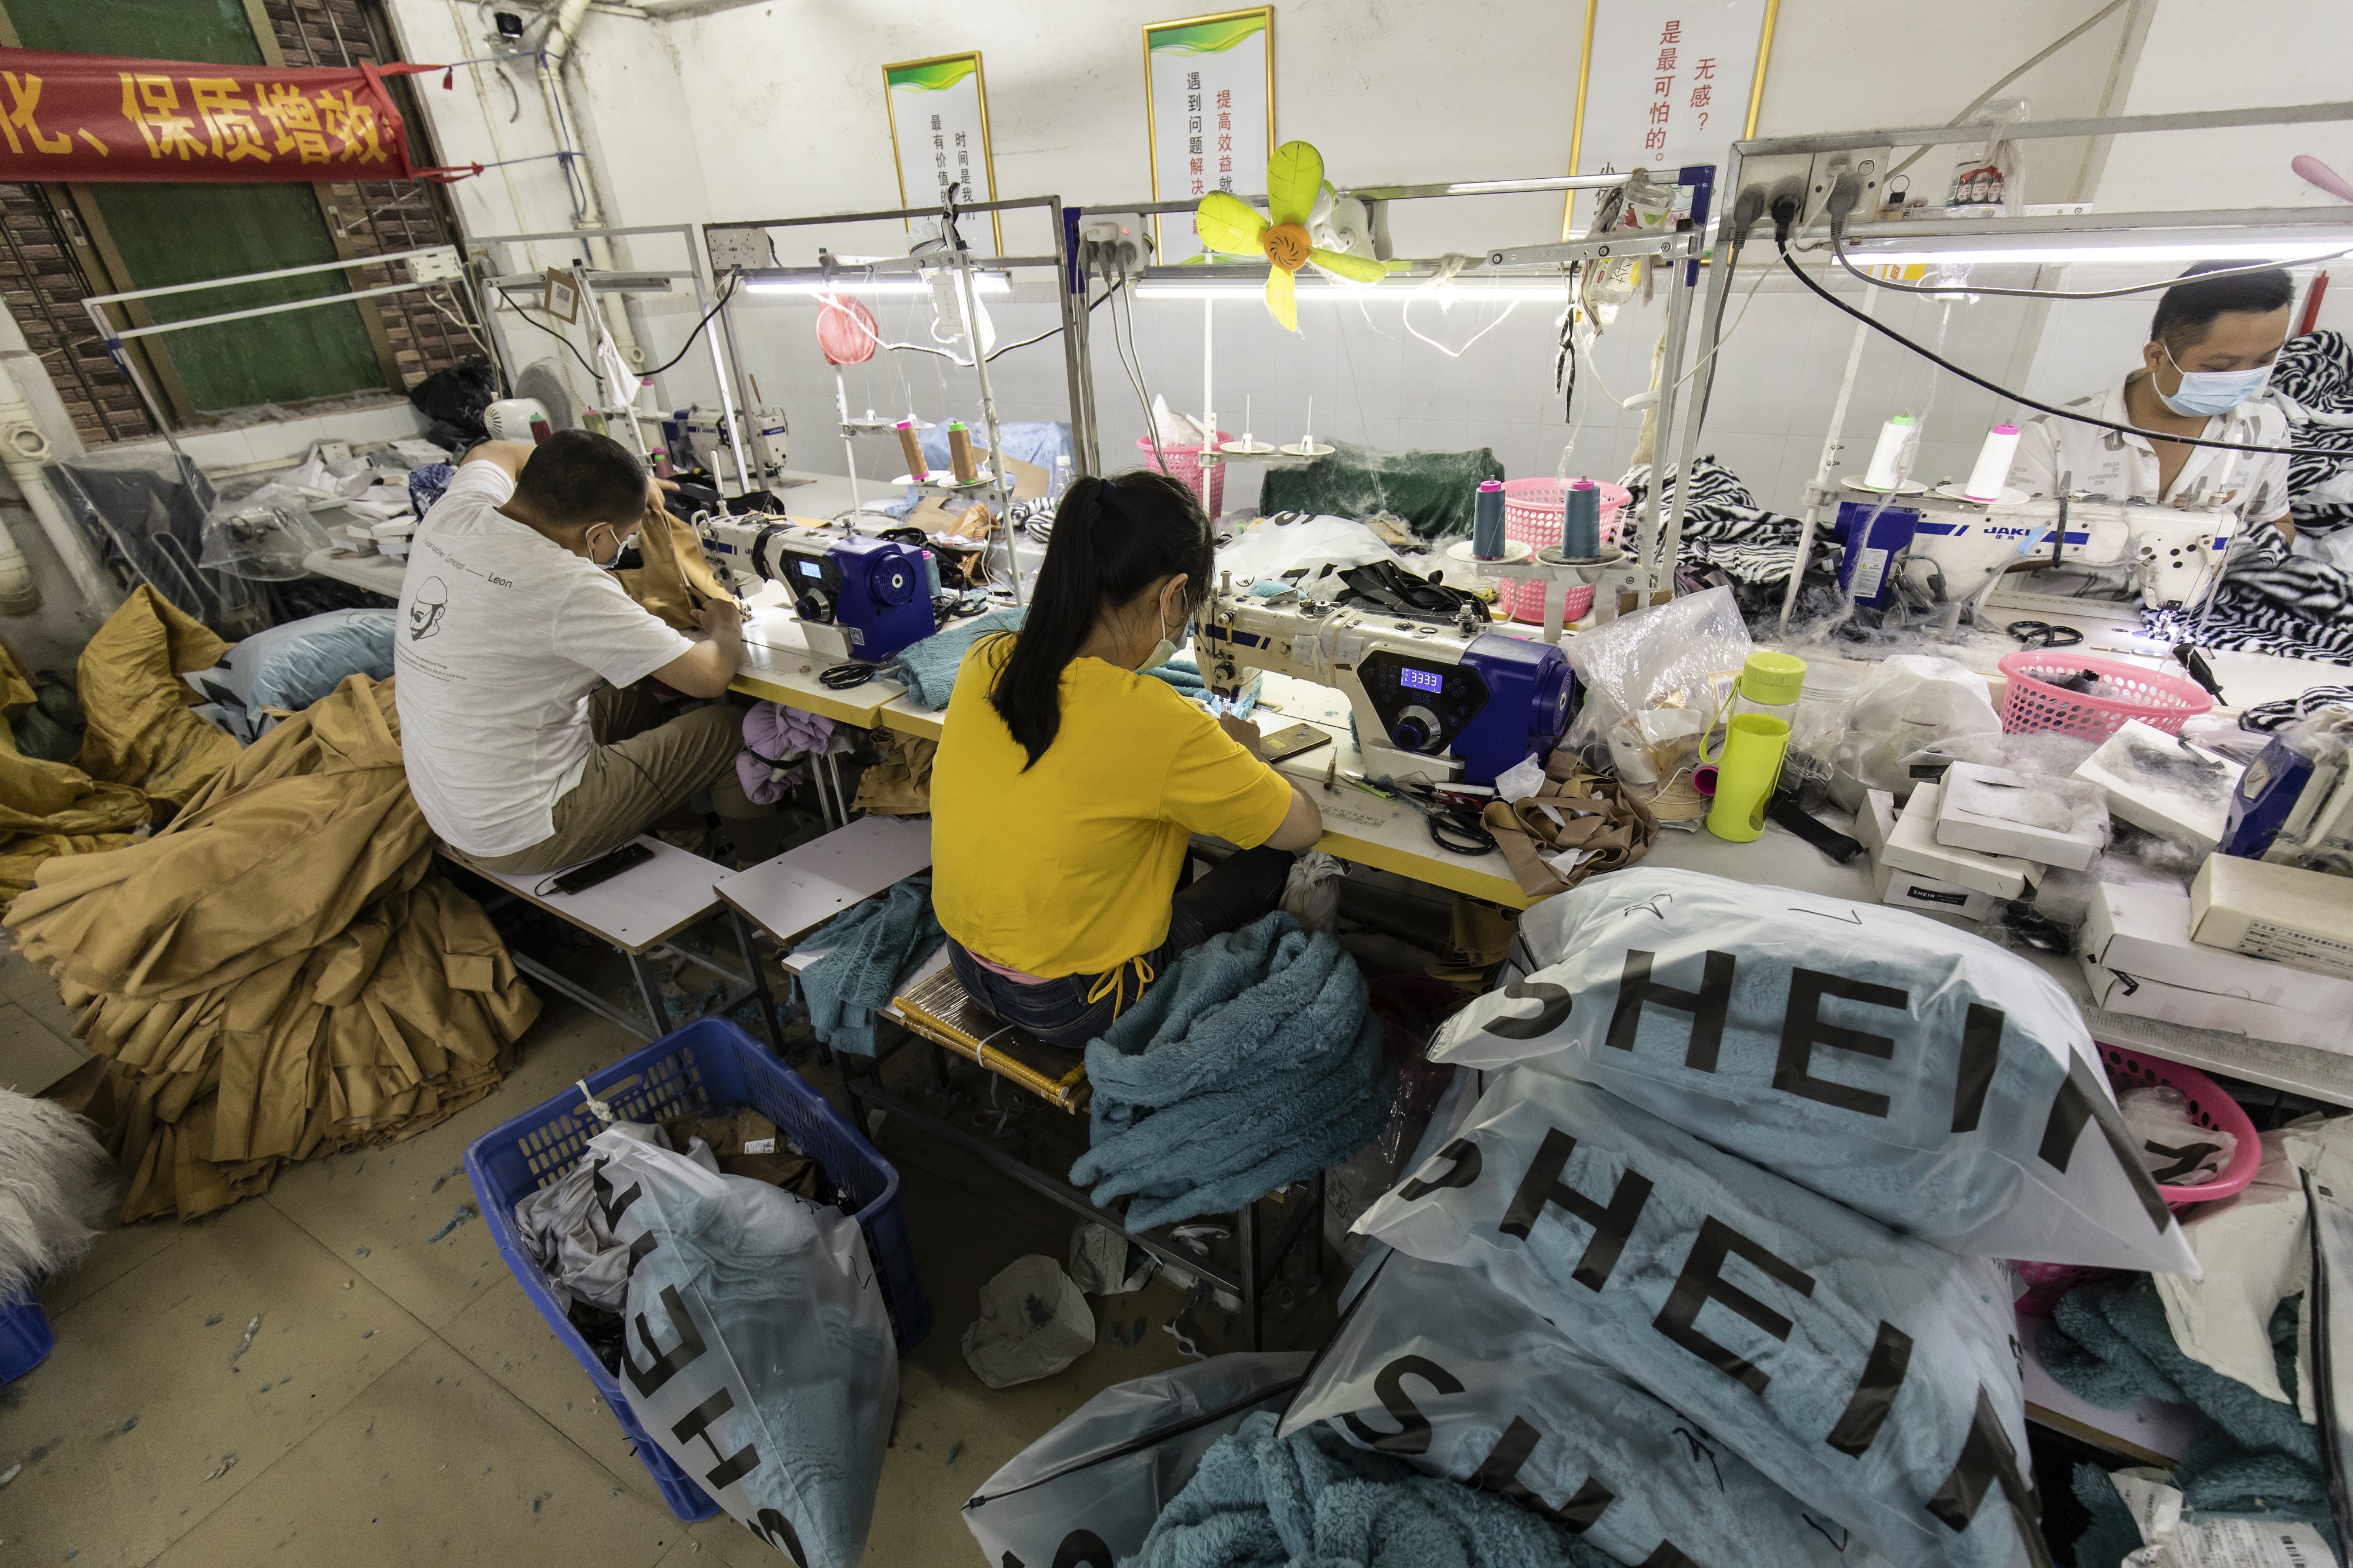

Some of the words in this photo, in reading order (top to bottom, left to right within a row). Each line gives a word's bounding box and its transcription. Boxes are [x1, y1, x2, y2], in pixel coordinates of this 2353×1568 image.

[1645, 19, 1681, 161] 是最可怕的。
[0, 71, 398, 164] 化、保质增效
[1216, 89, 1234, 193] 提高效益就
[1983, 527, 2031, 536] JAKI
[422, 535, 446, 558] haracter
[445, 553, 465, 571] Concept
[488, 572, 512, 588] Leon
[1411, 672, 1438, 687] 3333
[1913, 890, 1935, 898] SHEIN
